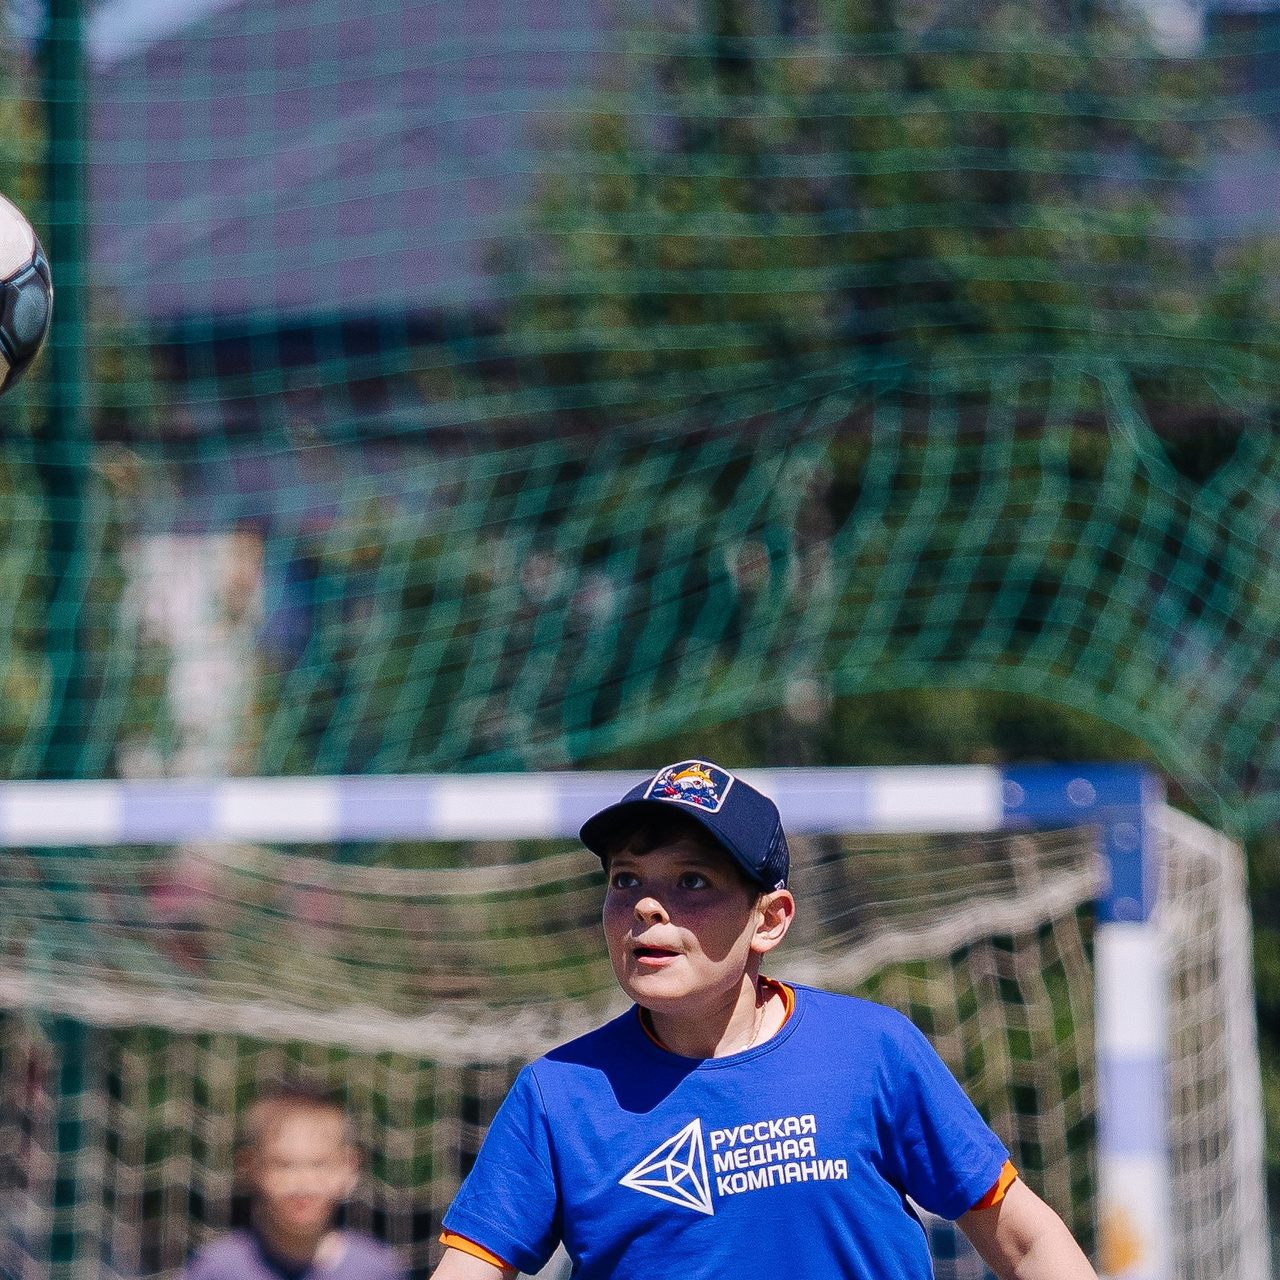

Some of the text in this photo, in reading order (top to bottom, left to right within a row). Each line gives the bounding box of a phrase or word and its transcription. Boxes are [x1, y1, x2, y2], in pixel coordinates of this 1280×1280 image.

[709, 1114, 817, 1151] РУССКАЯ
[712, 1137, 816, 1173] МЕДНАЯ
[716, 1159, 848, 1196] КОМПАНИЯ
